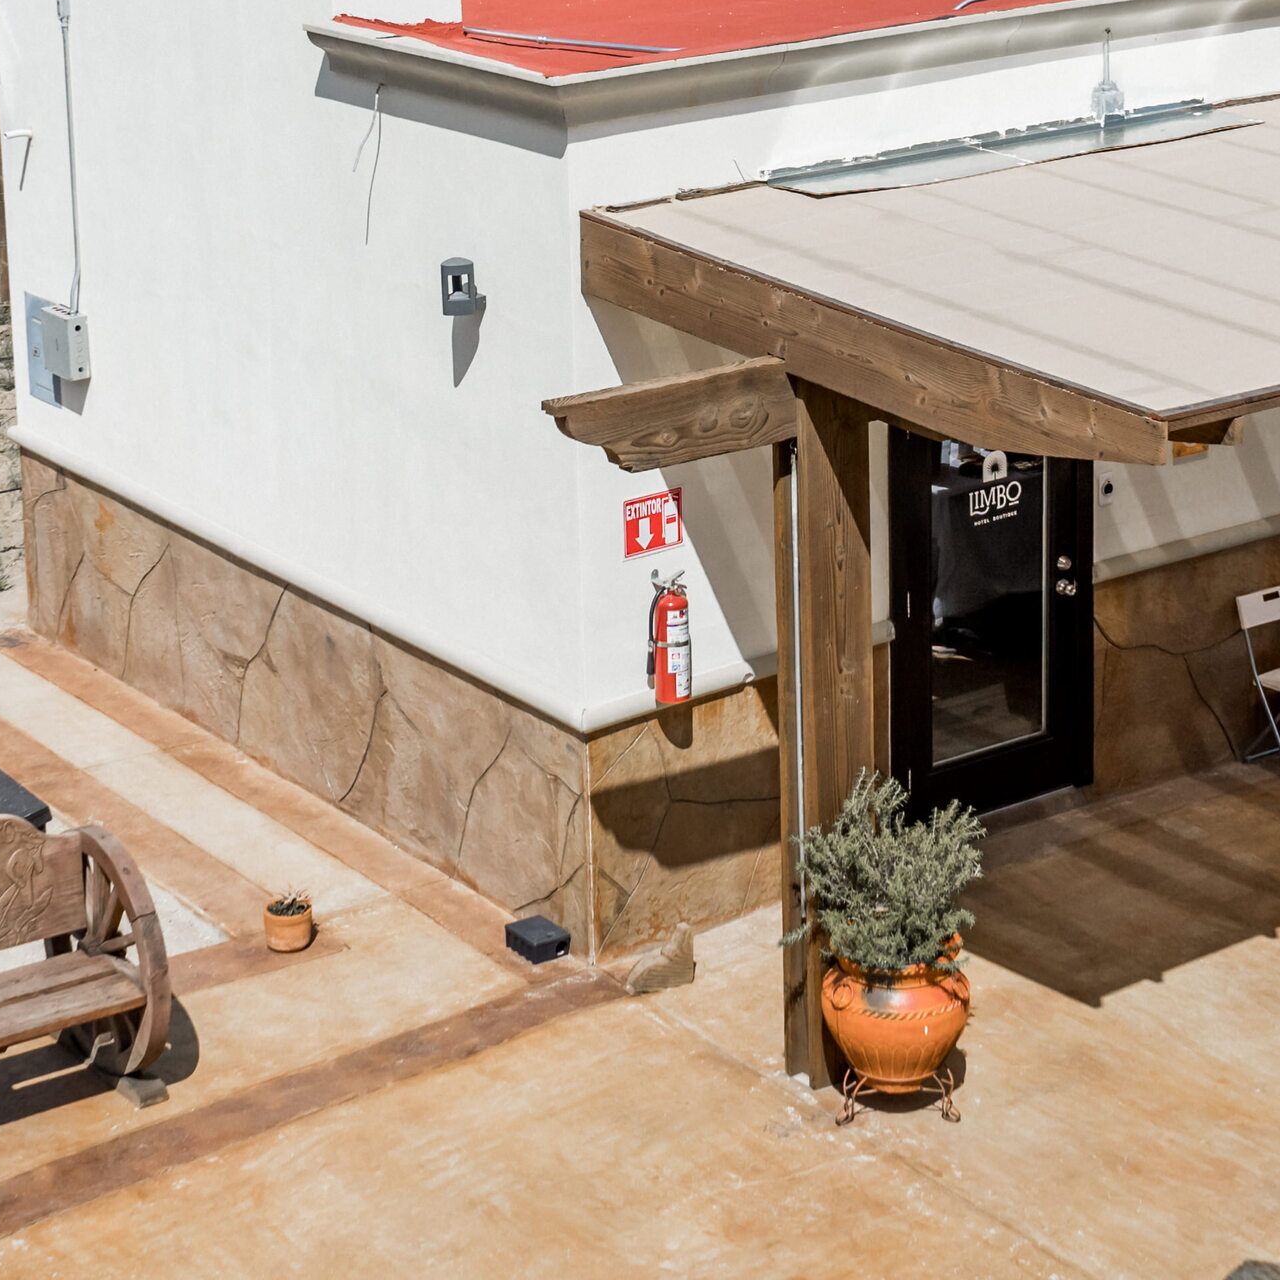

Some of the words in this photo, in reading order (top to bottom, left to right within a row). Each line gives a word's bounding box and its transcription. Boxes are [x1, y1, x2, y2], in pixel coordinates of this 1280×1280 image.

[626, 498, 662, 521] EXTINTOR
[968, 481, 1022, 517] LIMBO
[973, 518, 990, 526] HOTEL
[992, 510, 1018, 522] BOUTIQUE
